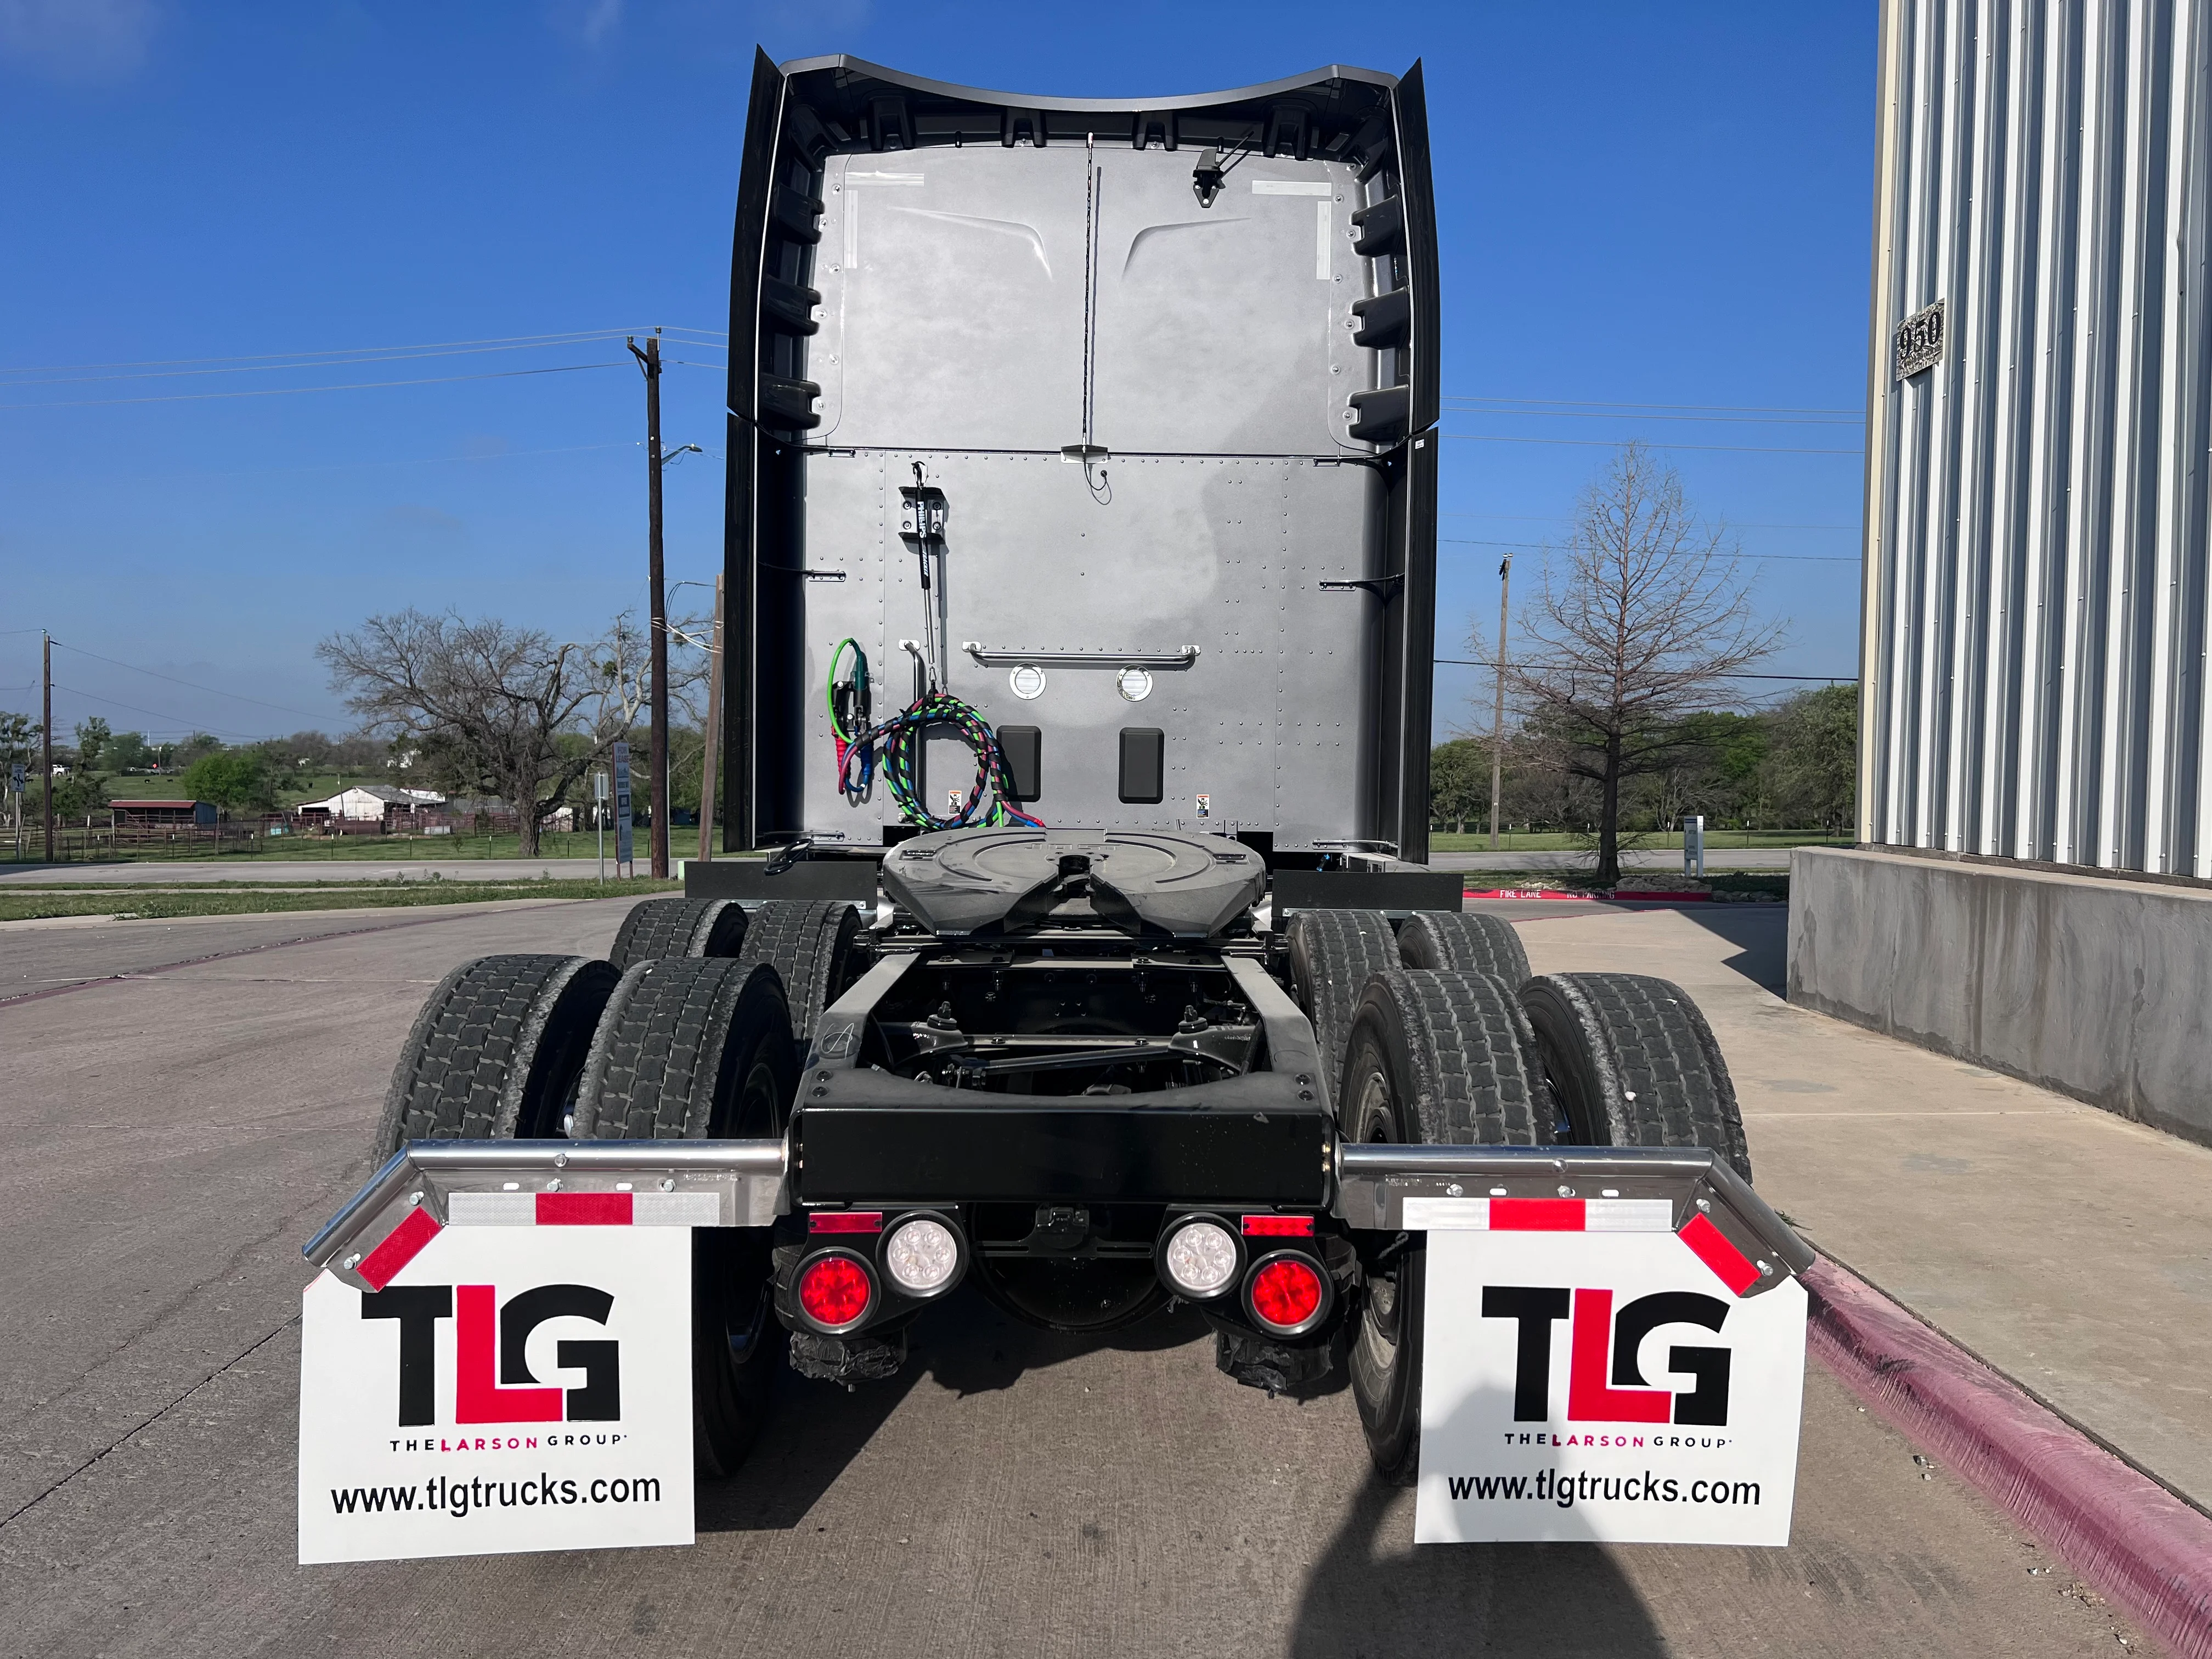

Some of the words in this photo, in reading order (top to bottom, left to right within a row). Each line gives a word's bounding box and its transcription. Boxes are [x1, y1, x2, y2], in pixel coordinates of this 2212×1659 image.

[1899, 311, 1942, 359] 950
[917, 501, 927, 538] PHILLIPS
[1500, 889, 1517, 898] FIRE
[1521, 889, 1542, 898] LANE
[361, 1284, 620, 1427] TLG
[1481, 1285, 1732, 1426] TLG
[548, 1434, 622, 1446] GROUP
[1654, 1436, 1726, 1448] GROUP
[330, 1472, 661, 1517] www.tlgtrucks.com
[1448, 1469, 1760, 1508] www.tlgtrucks.com
